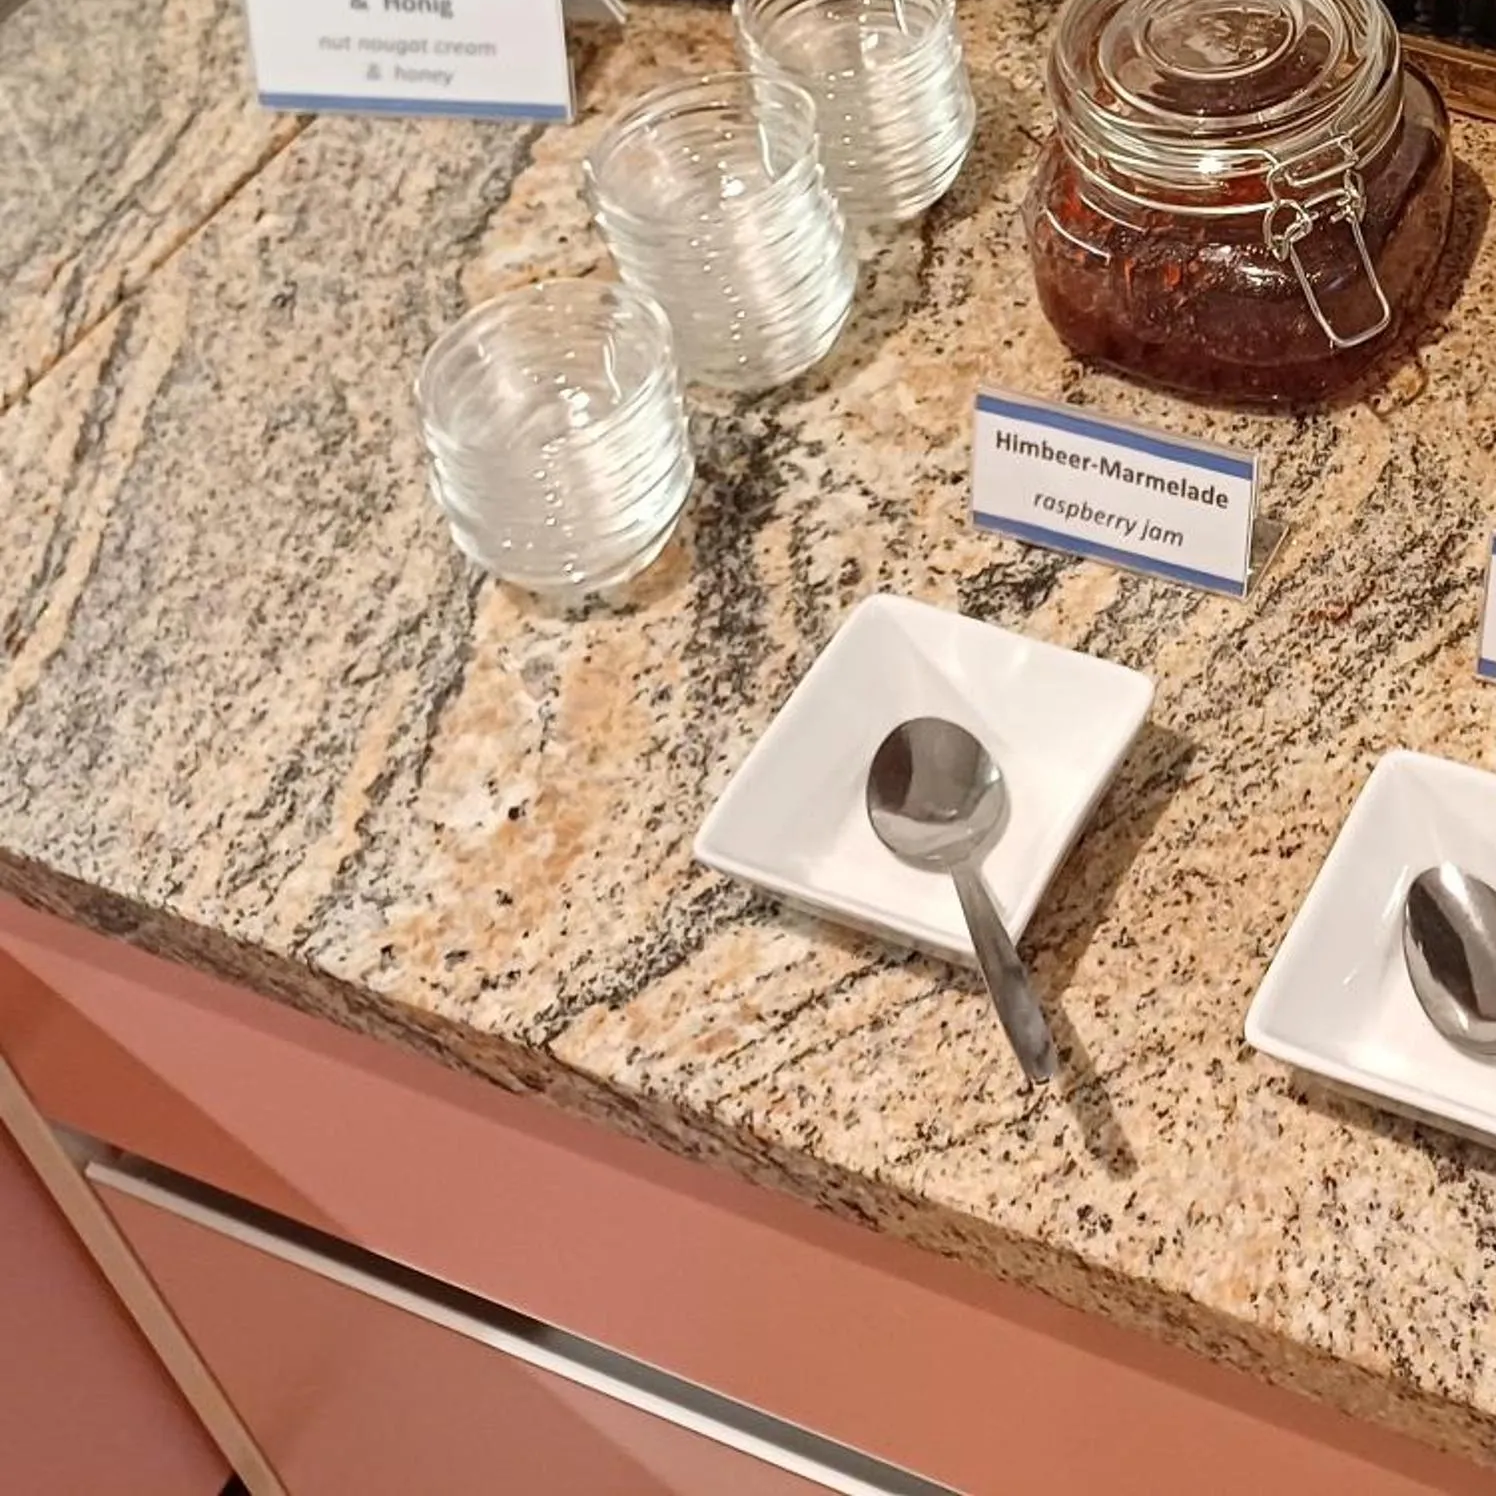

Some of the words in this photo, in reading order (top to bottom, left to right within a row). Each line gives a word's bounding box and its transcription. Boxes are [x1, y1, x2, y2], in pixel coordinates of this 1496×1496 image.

[318, 35, 350, 51] nut
[358, 36, 428, 56] nougat
[433, 41, 497, 56] cream
[366, 64, 381, 80] &
[394, 65, 454, 86] honey
[995, 430, 1229, 510] Himbeer-Marmelade
[1033, 493, 1138, 536] raspberry
[1140, 519, 1184, 547] jam
